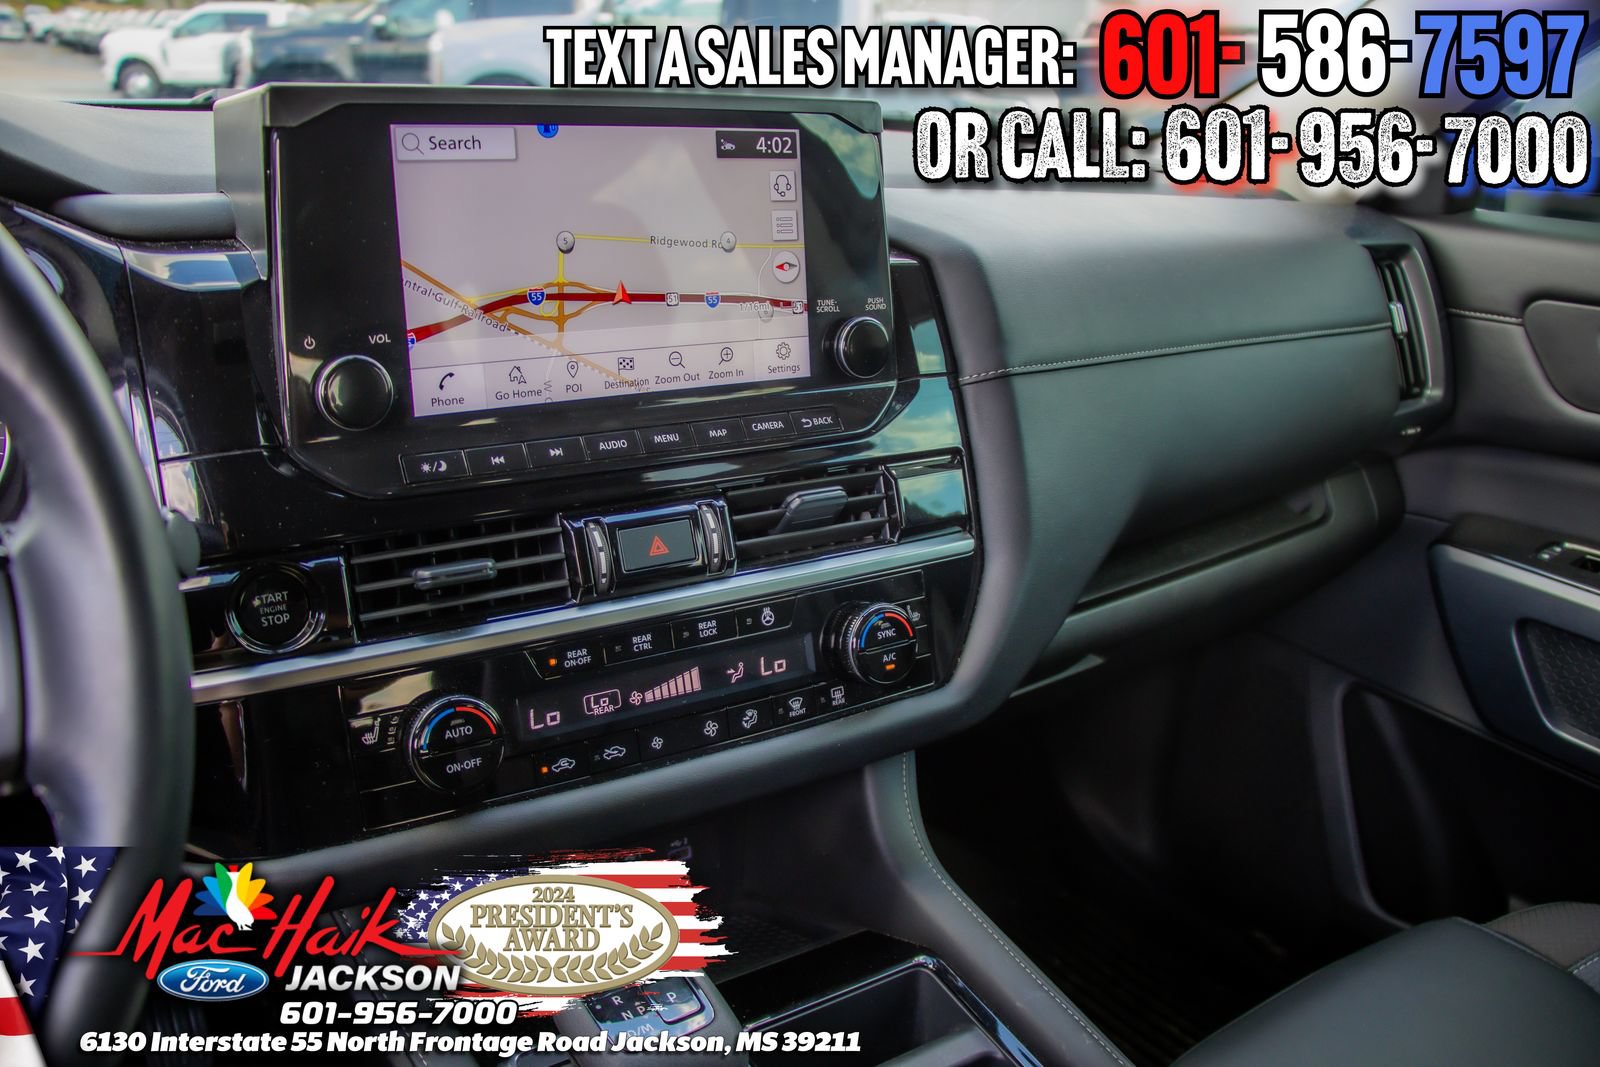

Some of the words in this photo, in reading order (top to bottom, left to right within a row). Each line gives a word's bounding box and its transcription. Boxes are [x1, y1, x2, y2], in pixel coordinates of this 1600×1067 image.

[428, 135, 482, 151] Search
[755, 136, 794, 155] 4:02
[562, 237, 569, 246] 5
[650, 235, 708, 249] Ridgewood
[530, 291, 544, 303] 55
[667, 293, 678, 305] 51
[707, 296, 718, 304] 55
[867, 297, 884, 305] PUSH
[816, 305, 840, 313] SCROLL
[865, 303, 887, 311] SOUND
[368, 333, 391, 345] VOL
[708, 369, 735, 380] Zoom
[736, 367, 744, 377] In
[767, 364, 801, 376] Settings
[604, 377, 650, 391] Destination
[655, 373, 682, 385] Zoom
[684, 371, 701, 382] Out
[495, 389, 509, 401] Go
[512, 387, 543, 400] Home
[565, 383, 583, 394] POI
[431, 396, 465, 408] Phone
[751, 420, 784, 431] CAMERA
[812, 415, 833, 426] BACK
[653, 432, 680, 444] MENU
[708, 428, 728, 438] MAP
[599, 438, 628, 451] AUDIO
[254, 590, 289, 605] START
[260, 603, 287, 615] ENGINE
[261, 613, 290, 627] STOP
[698, 619, 717, 631] REAR
[632, 633, 652, 645] REAR
[699, 628, 718, 638] LOCK
[877, 628, 897, 640] SYNC
[633, 641, 653, 652] CTRL
[567, 648, 588, 660] REAR
[882, 651, 897, 663] A/C
[760, 656, 787, 676] Lo
[590, 694, 609, 709] Lo
[832, 697, 845, 707] REAR
[593, 704, 615, 716] REAR
[789, 707, 807, 718] FRONT
[529, 708, 561, 730] Lo
[444, 726, 473, 740] AUTO
[611, 995, 624, 1006] R
[666, 991, 677, 1003] P
[621, 1010, 634, 1021] N
